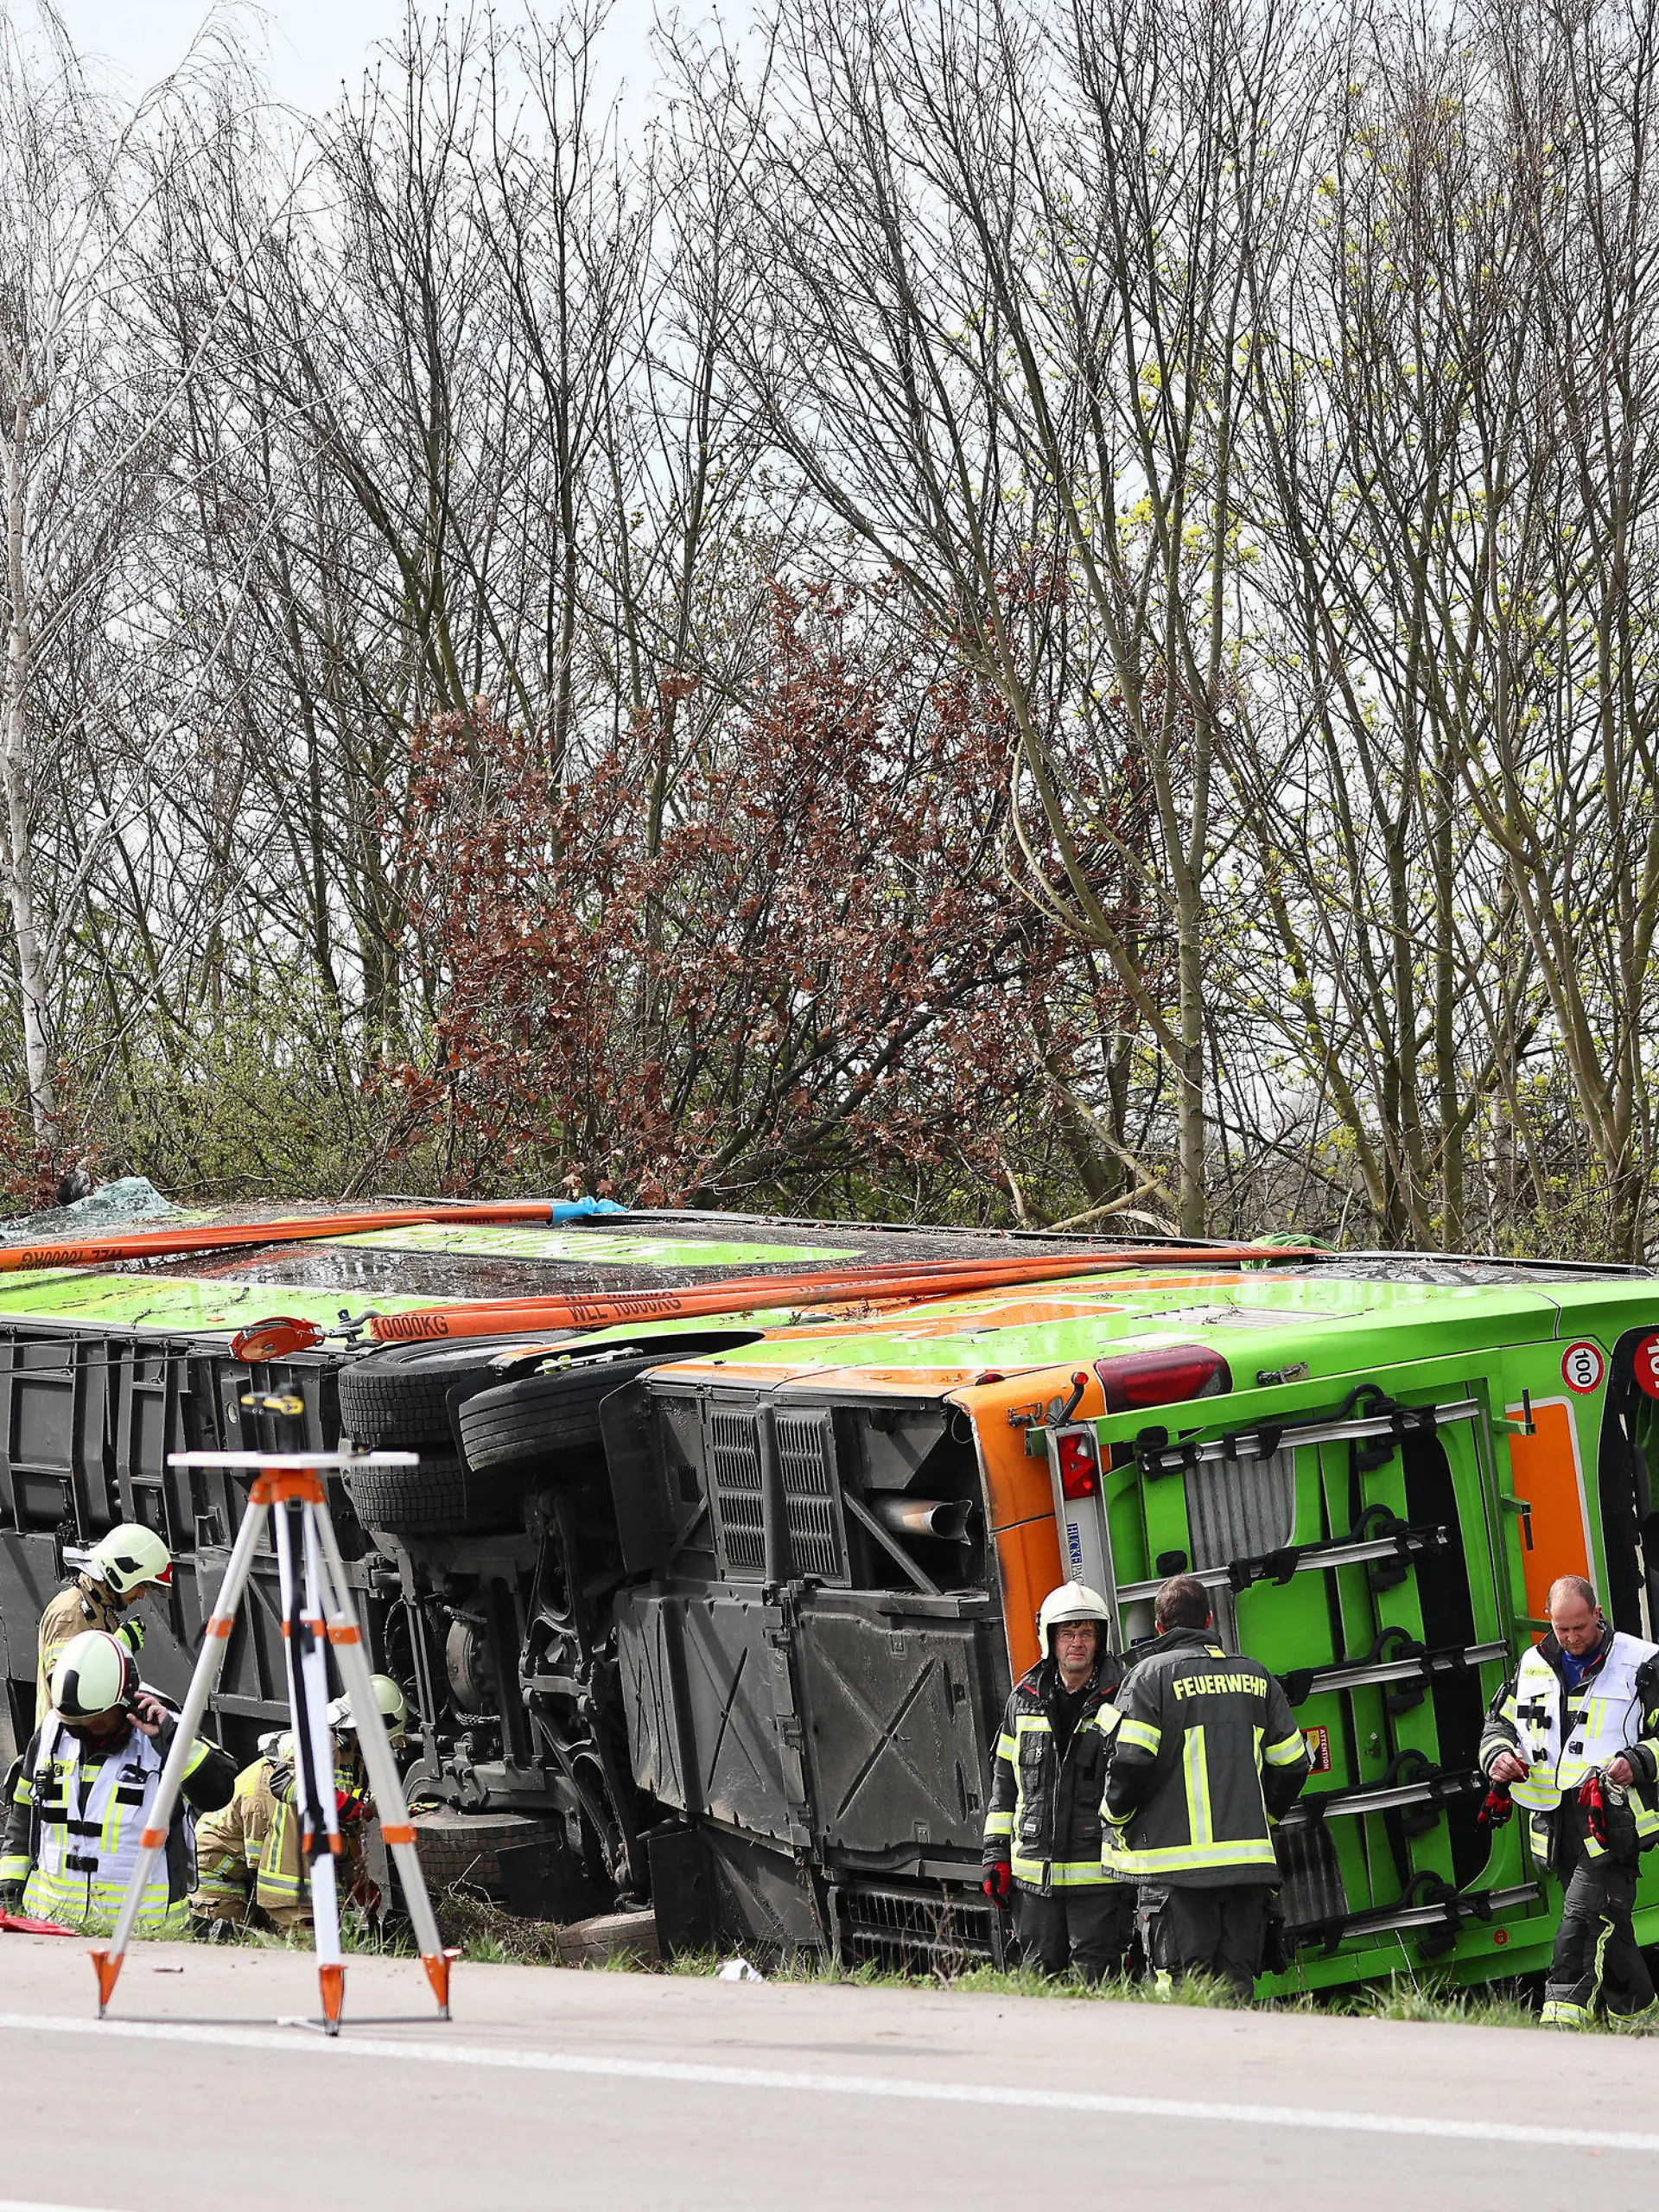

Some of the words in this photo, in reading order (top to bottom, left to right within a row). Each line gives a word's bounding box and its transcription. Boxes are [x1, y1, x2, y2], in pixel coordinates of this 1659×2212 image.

[372, 1314, 448, 1339] 10000KG
[569, 1303, 608, 1323] WLL
[1574, 1350, 1592, 1384] 100
[1066, 1522, 1084, 1586] HUCKEPAC
[1173, 1674, 1268, 1701] FEUERWEHR
[1319, 1729, 1330, 1770] ATTENTION
